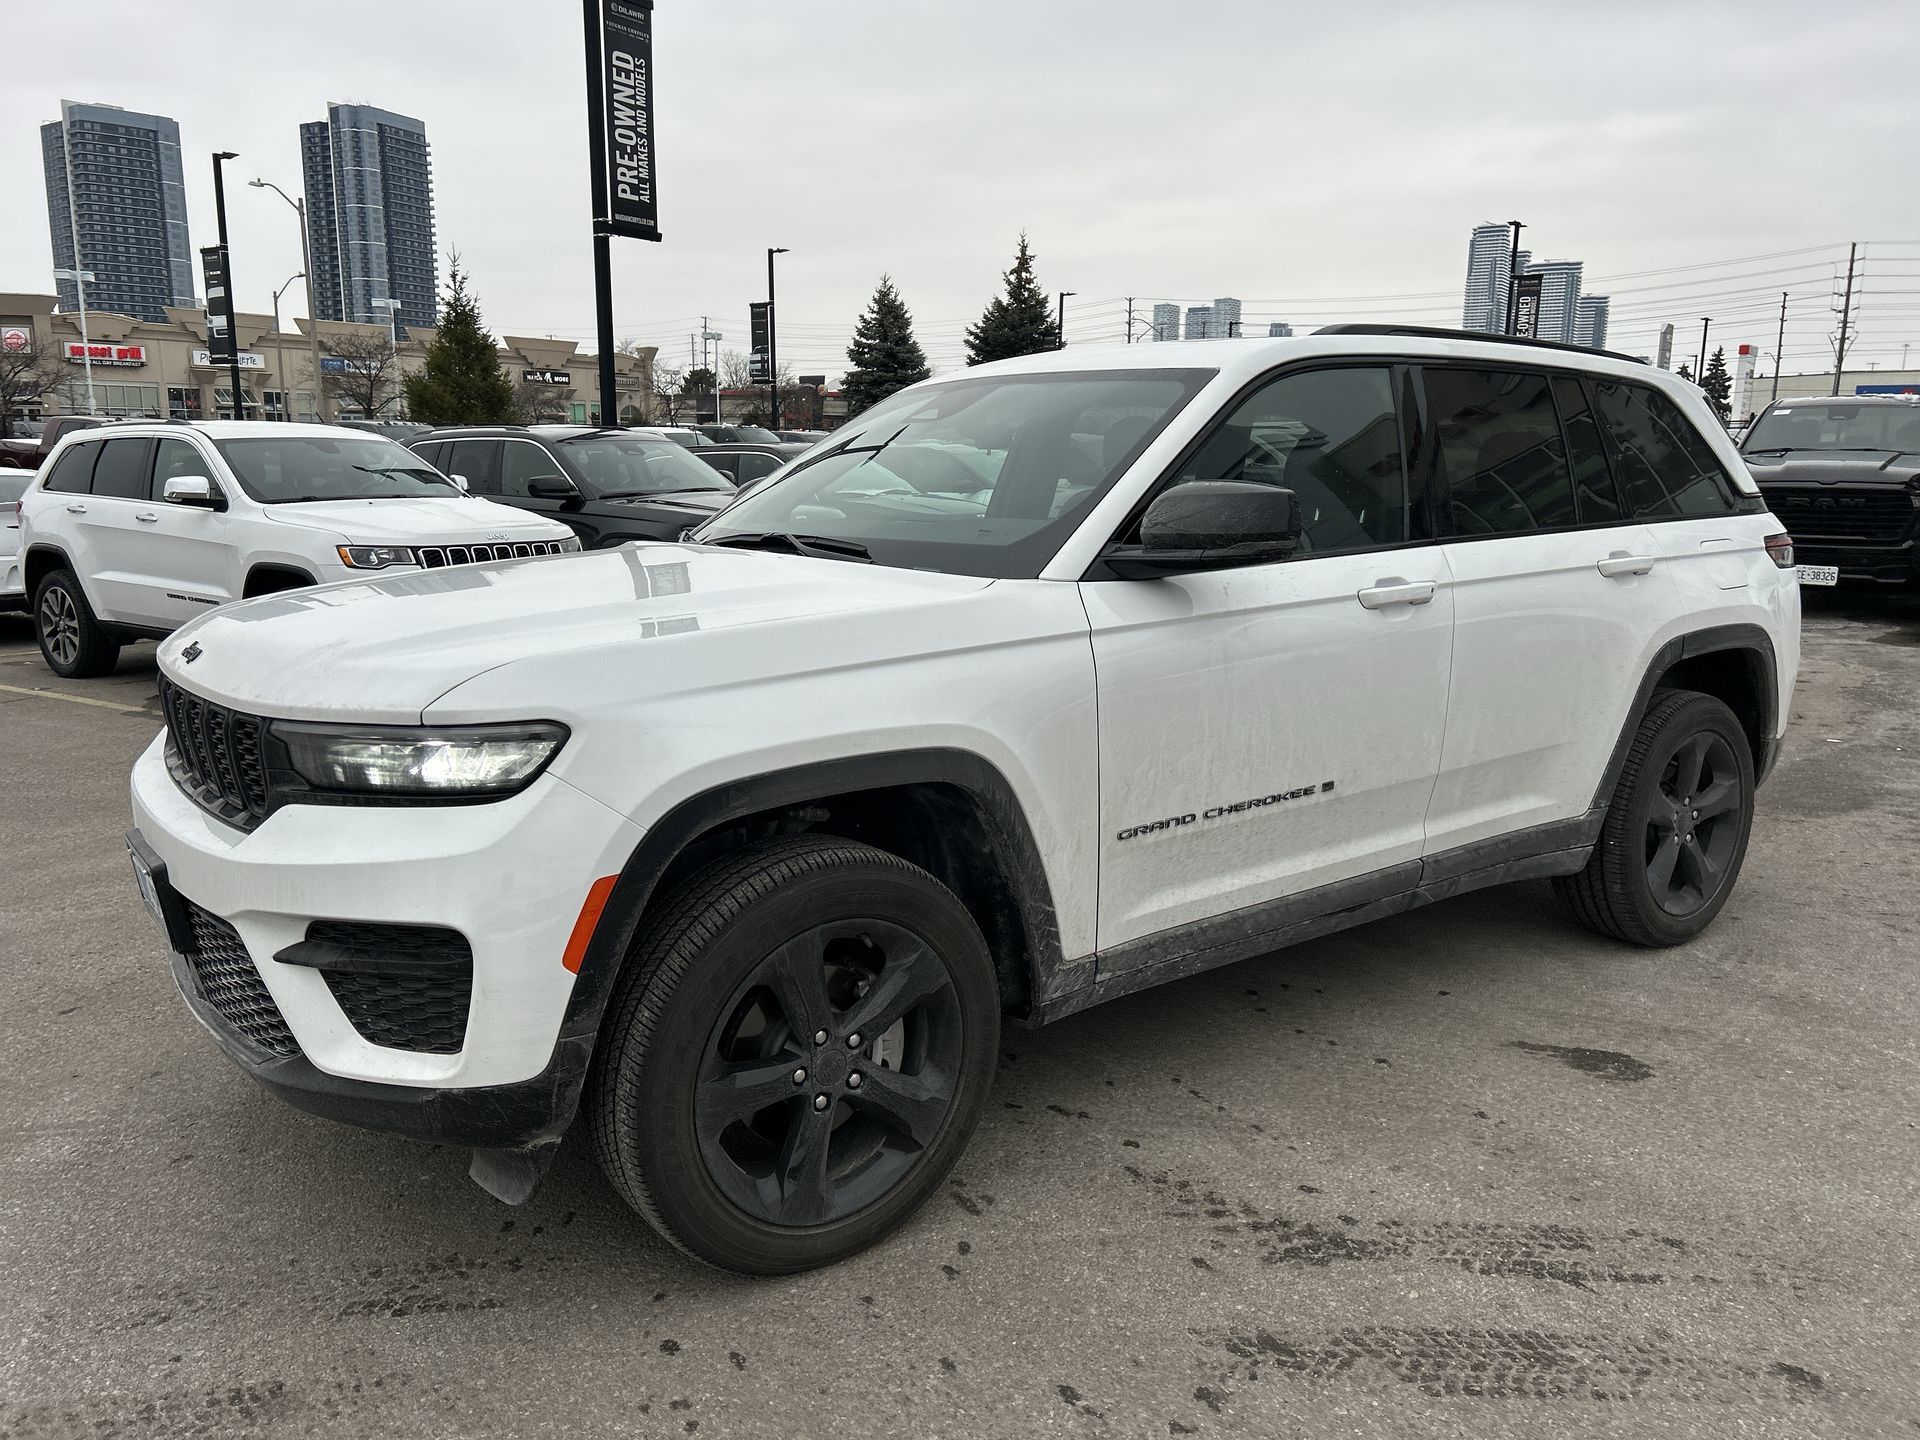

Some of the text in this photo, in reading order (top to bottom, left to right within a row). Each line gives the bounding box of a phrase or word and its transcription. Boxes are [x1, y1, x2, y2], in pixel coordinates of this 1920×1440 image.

[618, 5, 645, 20] DILAWRI
[612, 50, 639, 202] PRE-OWNED
[634, 57, 650, 204] ALL MAKES AND MODELS
[1516, 296, 1531, 337] E-OWNED
[116, 347, 143, 359] grill
[239, 356, 257, 365] LETTE
[487, 531, 510, 540] Jeep
[1811, 570, 1836, 581] 38326
[1116, 784, 1316, 841] GRAND CHEROKEE
